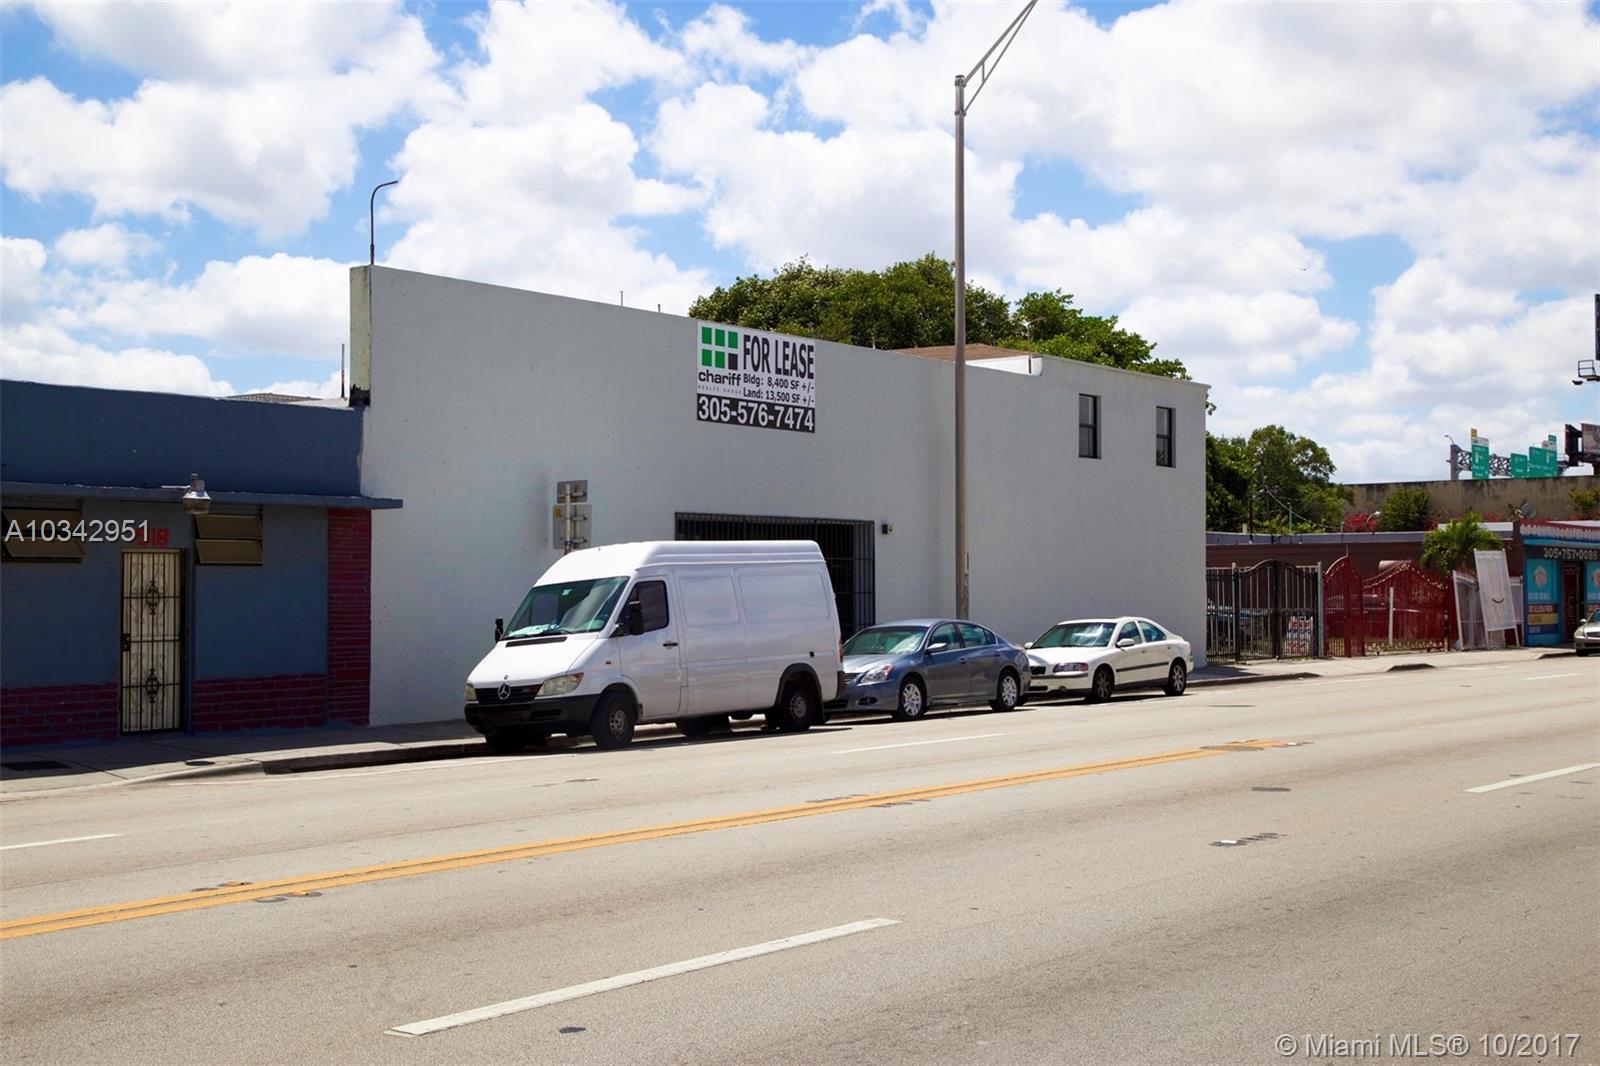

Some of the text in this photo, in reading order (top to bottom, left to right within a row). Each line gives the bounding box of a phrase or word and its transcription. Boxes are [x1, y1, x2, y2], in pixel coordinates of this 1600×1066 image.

[743, 334, 815, 380] FOR LEASE
[698, 369, 742, 387] chariff
[743, 373, 764, 388] Bldg:
[767, 376, 789, 389] 8,400
[790, 380, 800, 390] SF
[743, 387, 764, 399] Land:
[766, 390, 790, 403] 13,500
[791, 393, 801, 403] SF
[698, 395, 814, 431] 305-576-7474
